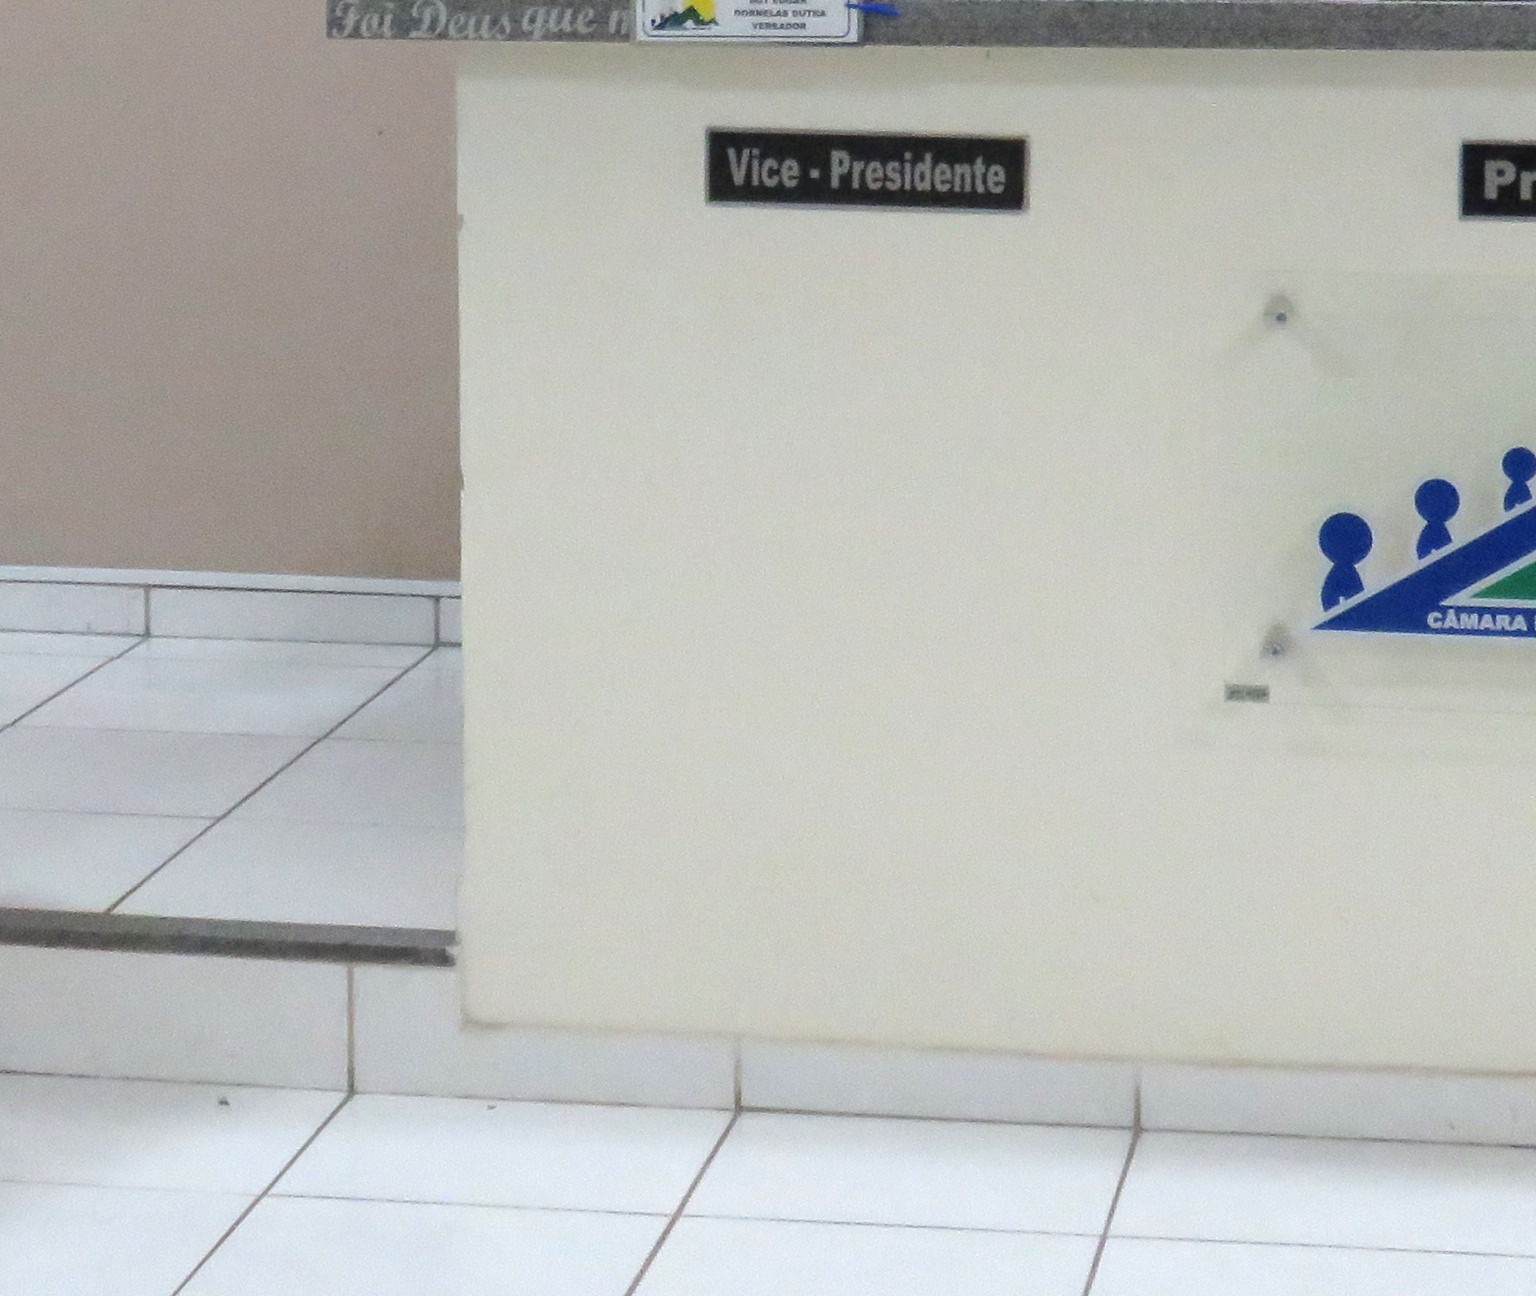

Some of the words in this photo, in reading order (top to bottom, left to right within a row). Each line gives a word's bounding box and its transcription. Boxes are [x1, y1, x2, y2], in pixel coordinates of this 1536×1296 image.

[521, 5, 596, 40] que
[726, 147, 800, 189] Vice
[830, 150, 1006, 195] Presidente
[1426, 609, 1528, 632] CÂMARA
